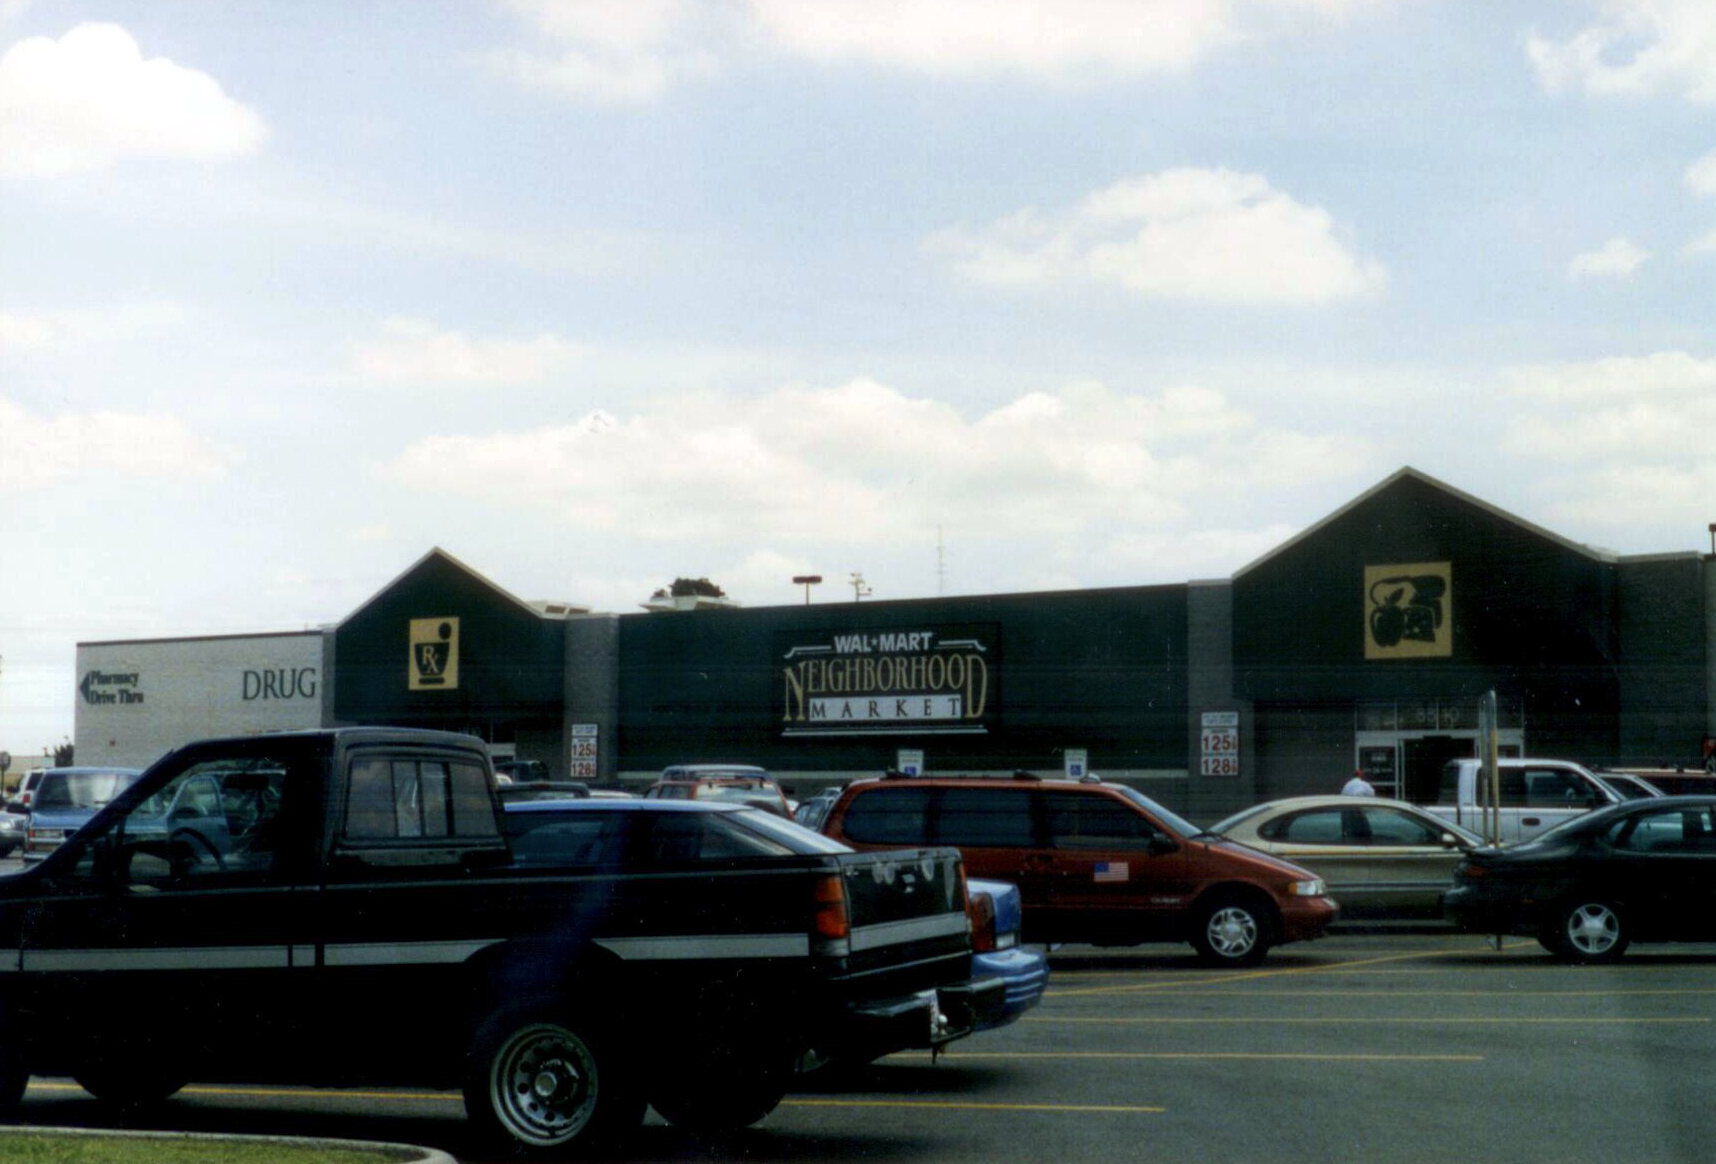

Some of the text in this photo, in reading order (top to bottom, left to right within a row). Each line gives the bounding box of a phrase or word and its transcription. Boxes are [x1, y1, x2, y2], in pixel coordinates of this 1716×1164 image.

[90, 670, 140, 687] Pharmacy
[242, 667, 317, 700] DRUG
[783, 653, 987, 721] NEIGHBORHOOD
[90, 689, 144, 704] Drive Thru
[811, 697, 960, 718] MARKET
